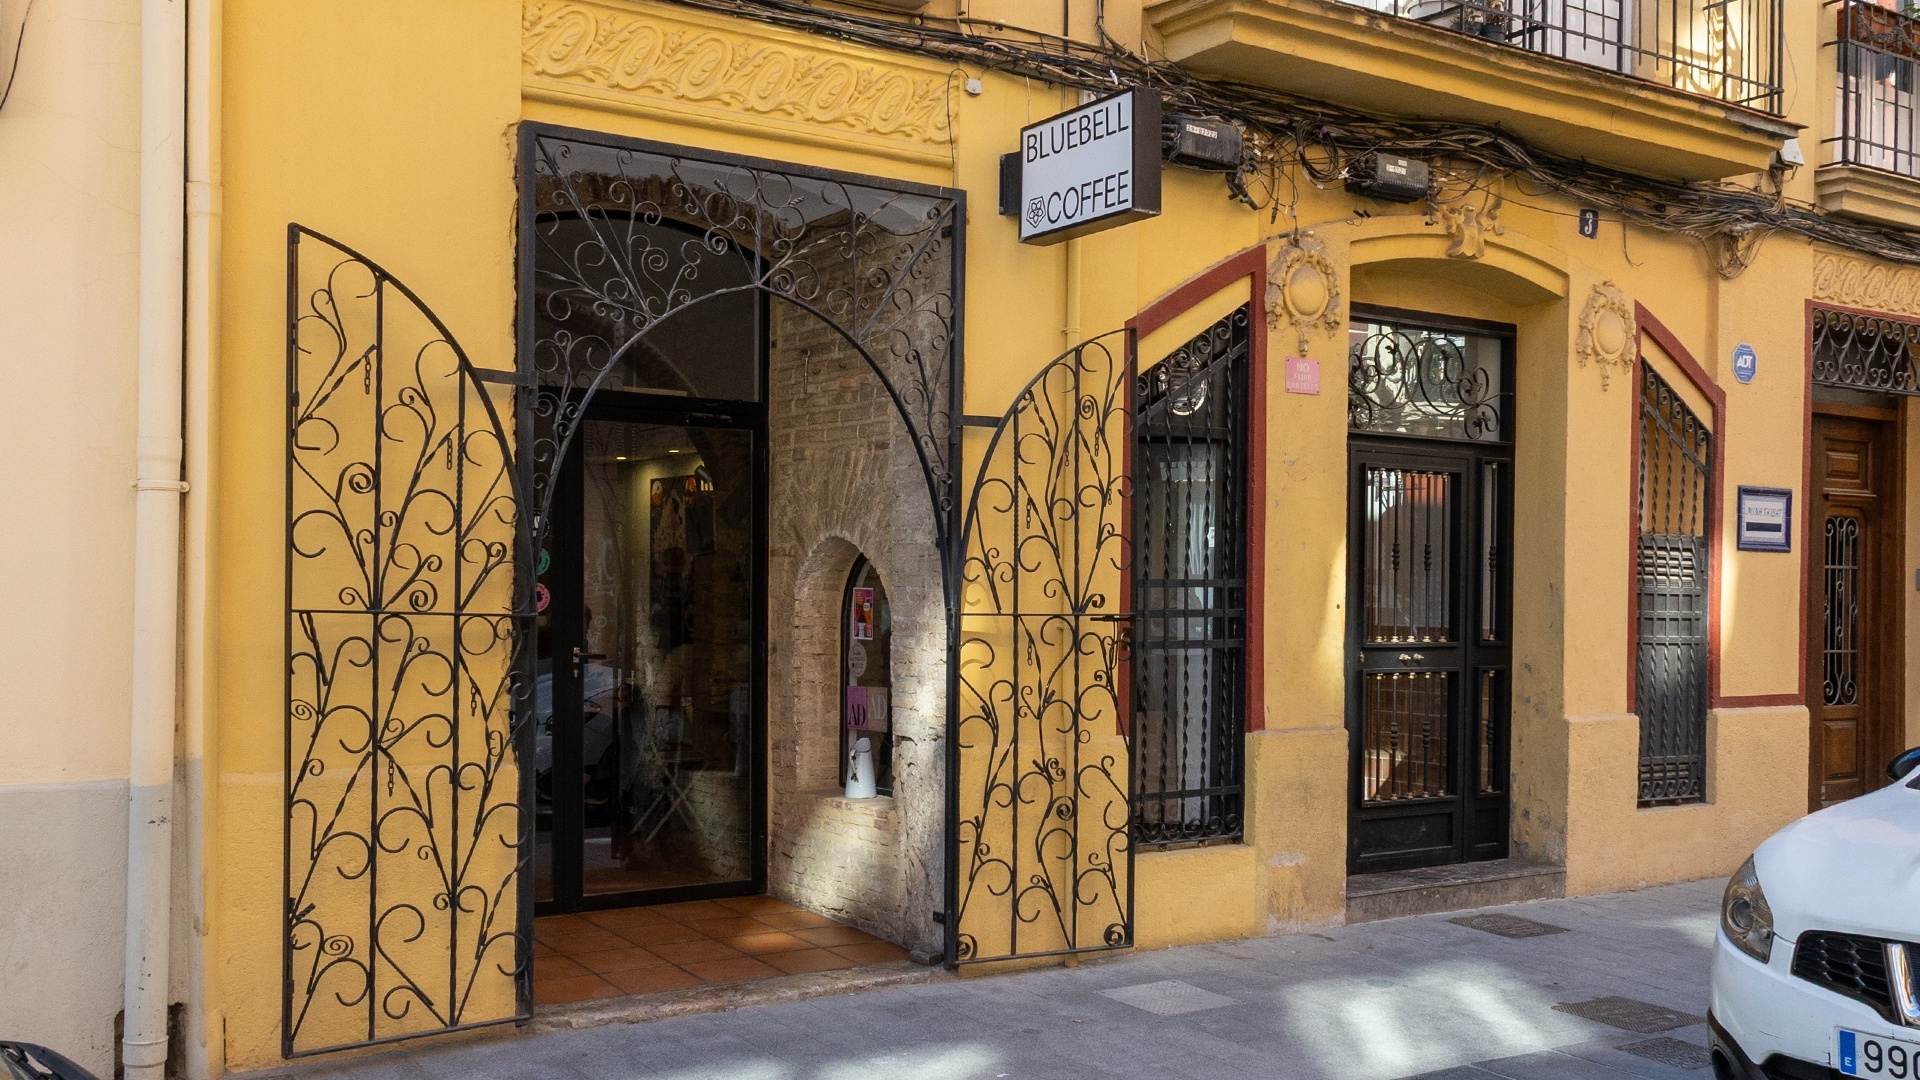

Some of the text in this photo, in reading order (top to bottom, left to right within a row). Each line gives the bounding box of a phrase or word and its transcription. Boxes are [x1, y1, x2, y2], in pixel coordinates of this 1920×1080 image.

[1026, 102, 1129, 163] BLUEBELL
[1047, 170, 1129, 224] COFFEE
[1584, 212, 1593, 235] 3
[1296, 362, 1310, 372] NO
[1737, 355, 1753, 369] ADT
[1287, 382, 1319, 390] CARTELES
[1844, 1057, 1852, 1067] E
